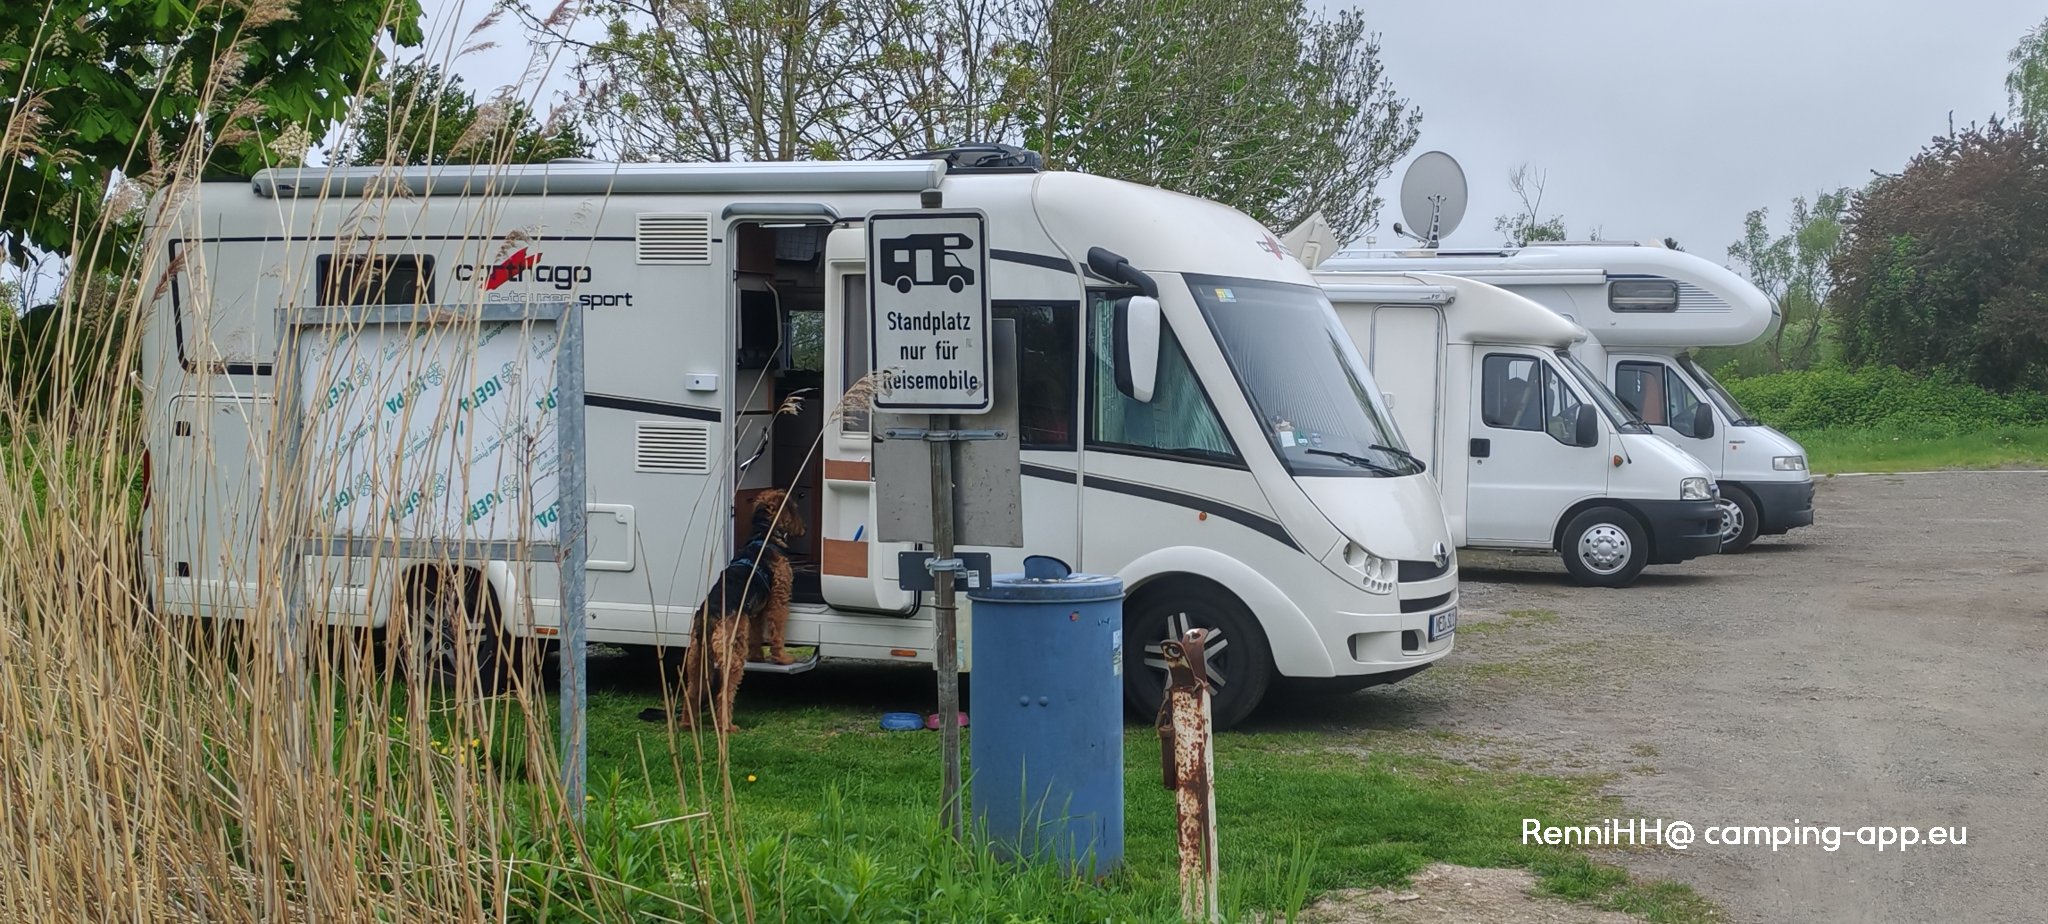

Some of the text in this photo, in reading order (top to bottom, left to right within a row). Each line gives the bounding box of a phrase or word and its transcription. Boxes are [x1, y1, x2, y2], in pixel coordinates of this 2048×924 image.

[579, 293, 632, 310] sport
[887, 311, 971, 336] Standplatz
[900, 341, 959, 361] nur für
[882, 370, 978, 391] Reisemobile
